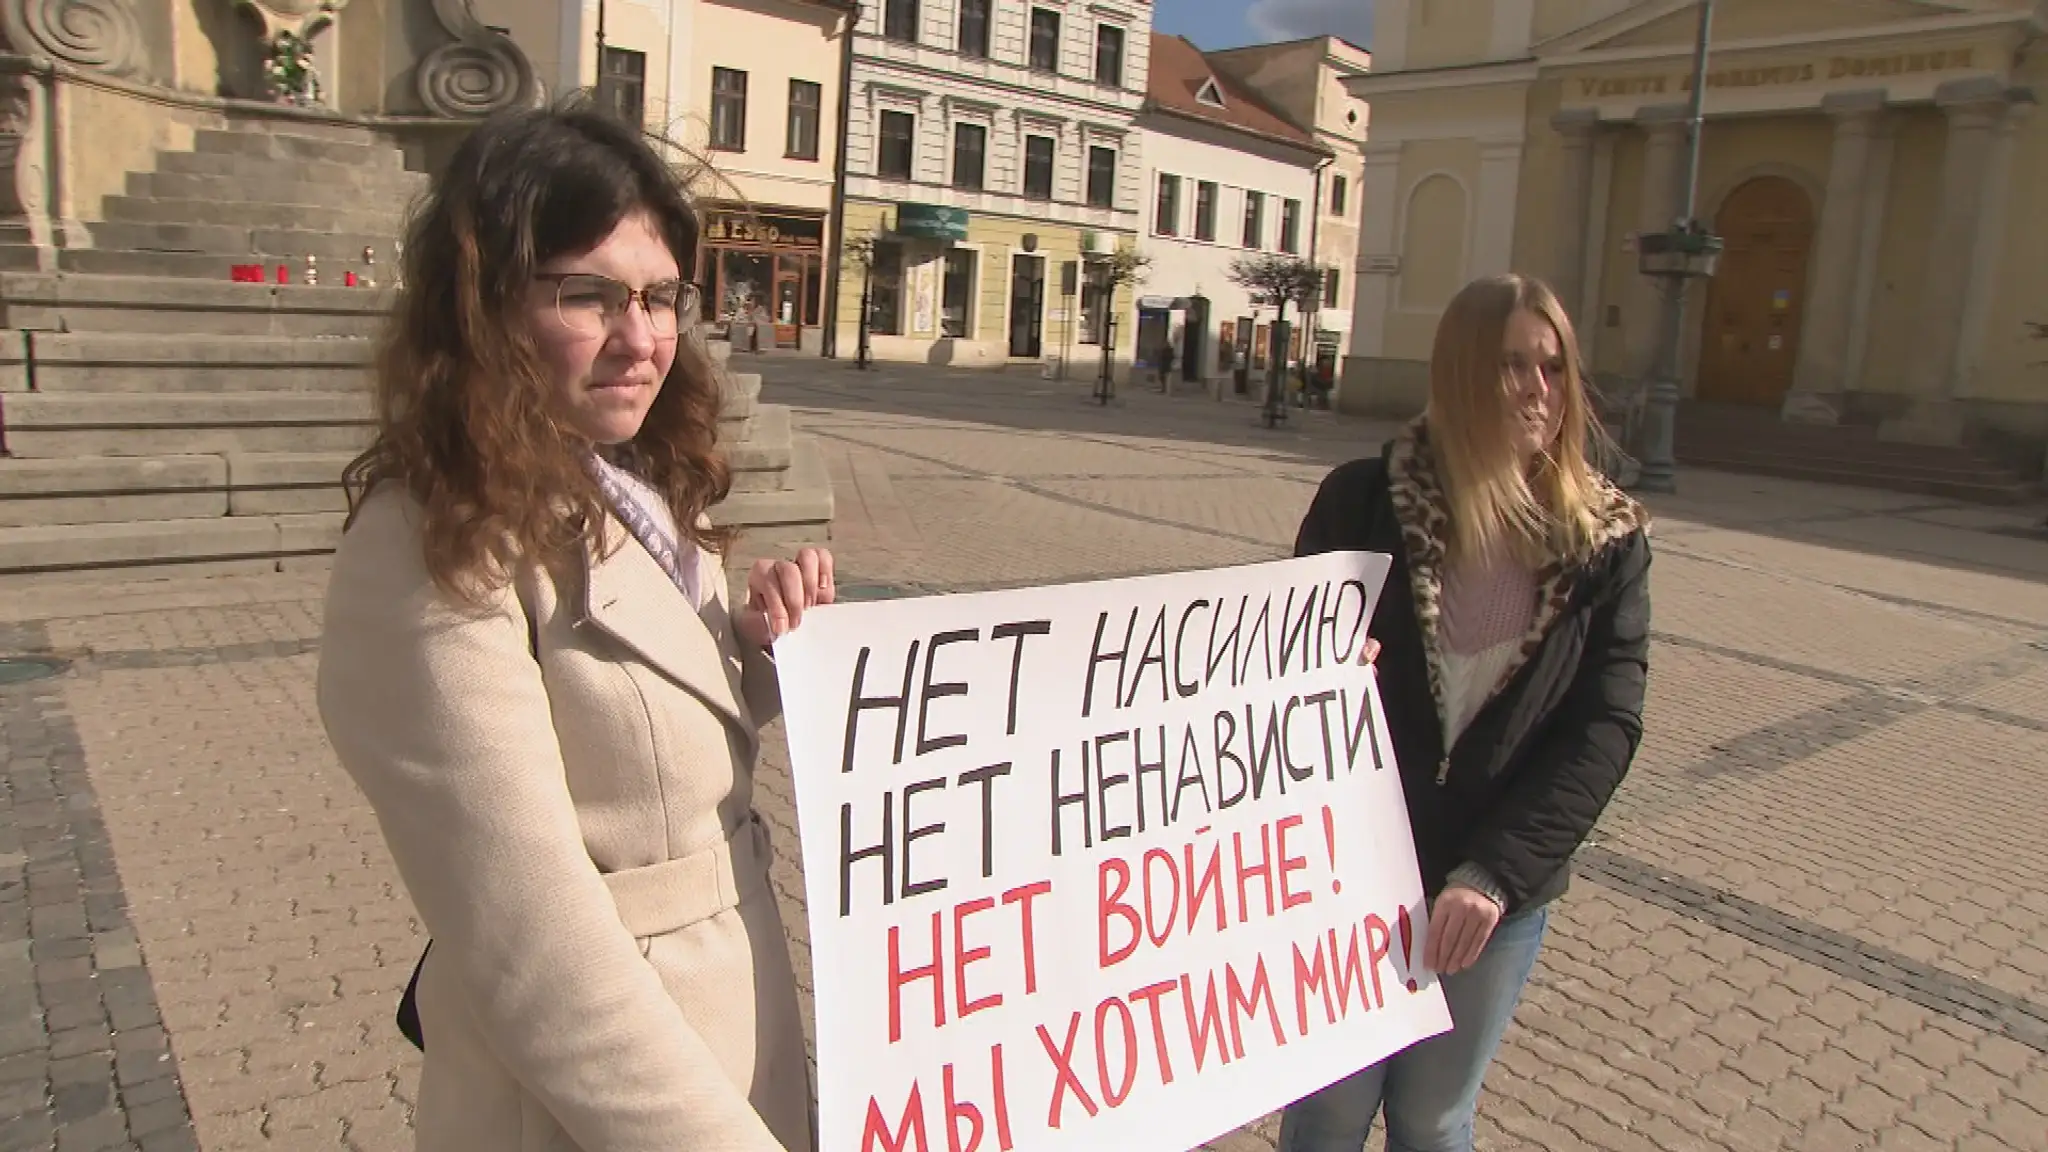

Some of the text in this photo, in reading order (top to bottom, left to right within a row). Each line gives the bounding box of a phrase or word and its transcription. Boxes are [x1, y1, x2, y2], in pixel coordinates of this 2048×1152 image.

[841, 579, 1367, 774] НЕТ НАСИЛИЮ
[839, 686, 1384, 919] НЕТ НЕНАВИСТИ
[860, 903, 1419, 1152] МЫ ХОТИМ МИР!
[887, 804, 1342, 1045] НЕТ ВОЙНЕ!
